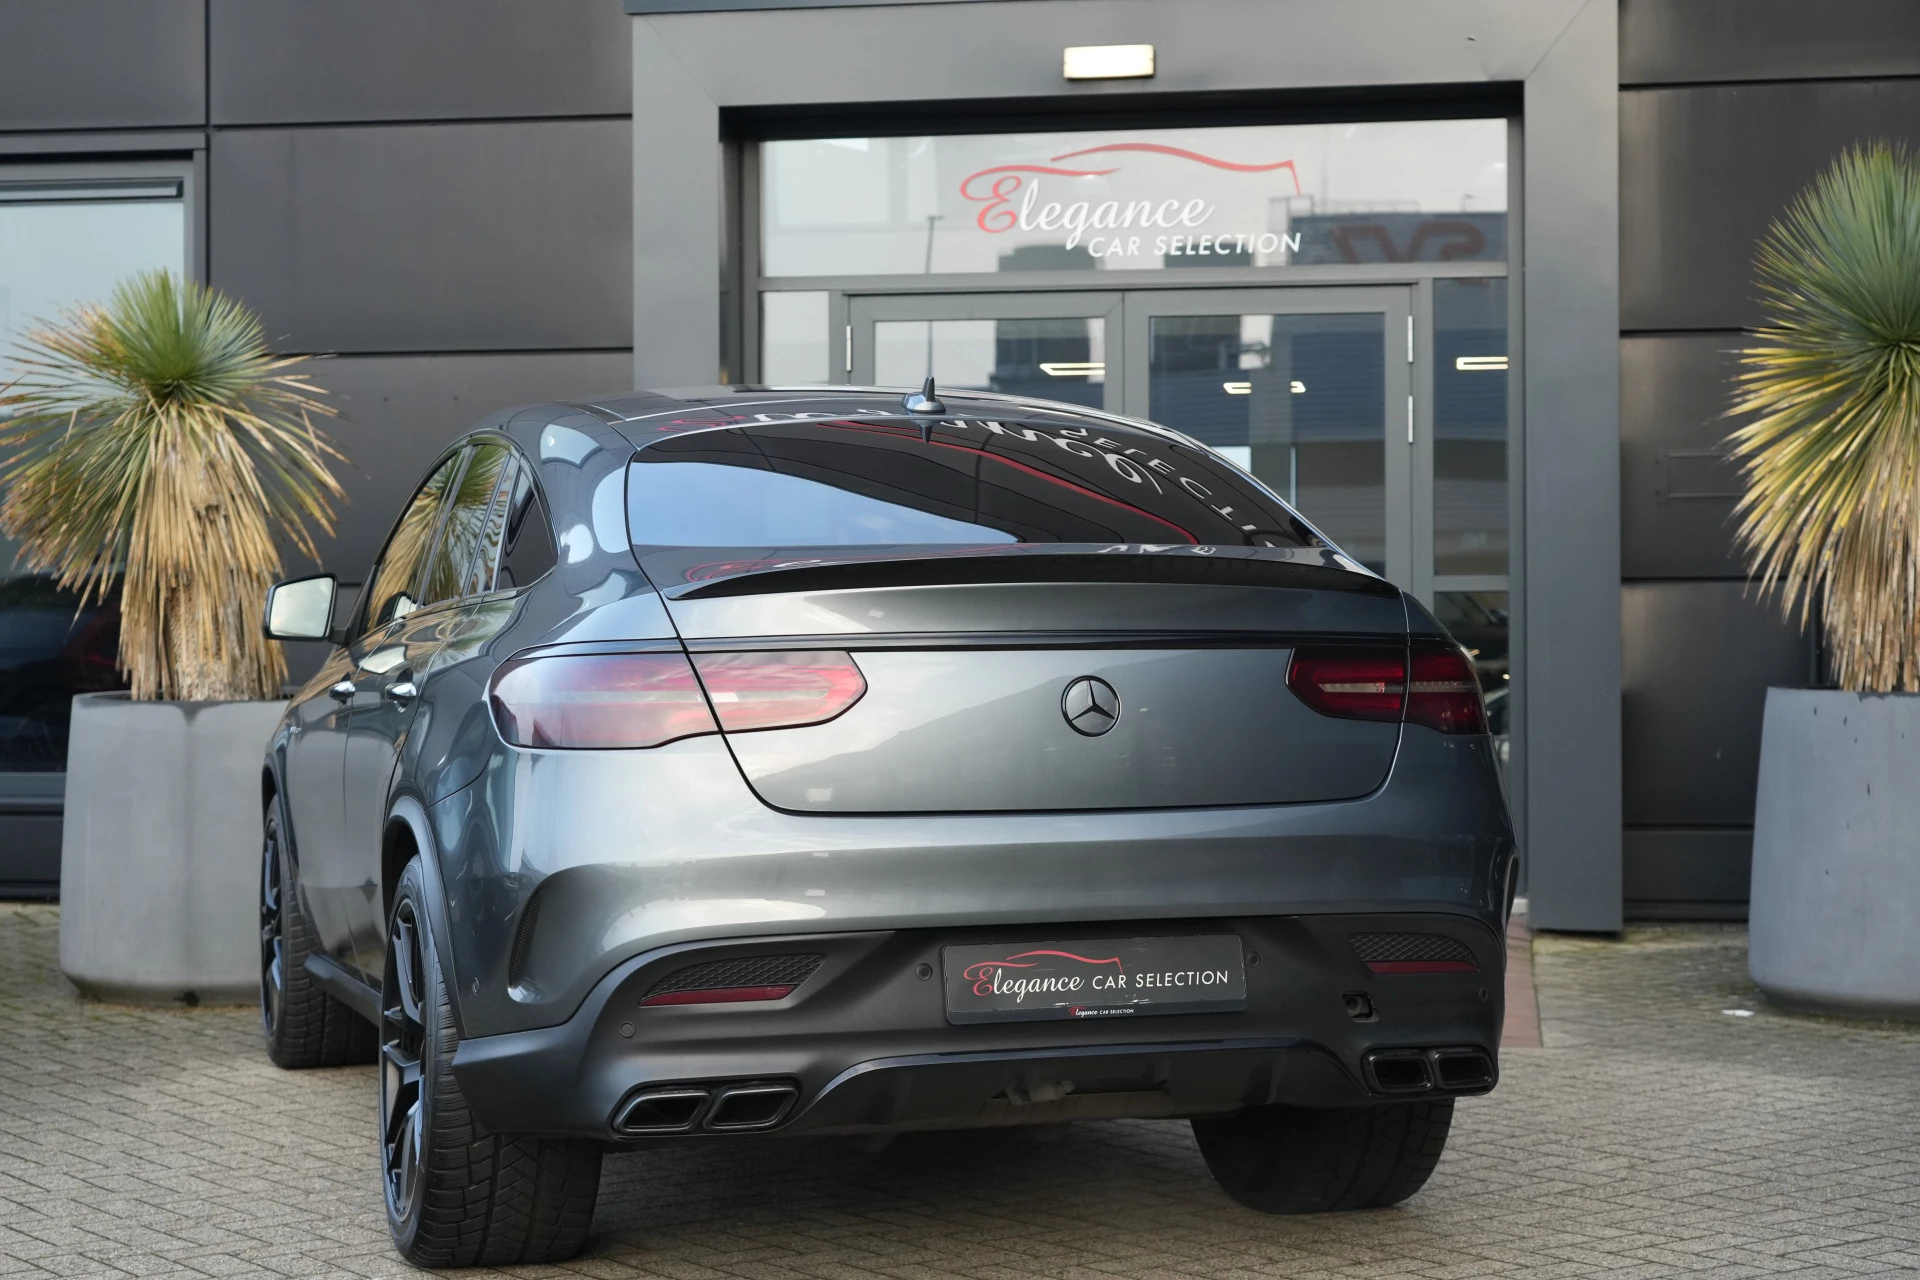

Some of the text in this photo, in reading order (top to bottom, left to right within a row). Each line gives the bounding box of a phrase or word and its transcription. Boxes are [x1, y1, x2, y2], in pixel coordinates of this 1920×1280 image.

[961, 166, 1215, 250] Elegance
[1087, 236, 1140, 258] CAR
[1153, 232, 1302, 257] SELECTION
[963, 961, 1229, 1003] Elegance CAR SELECTION
